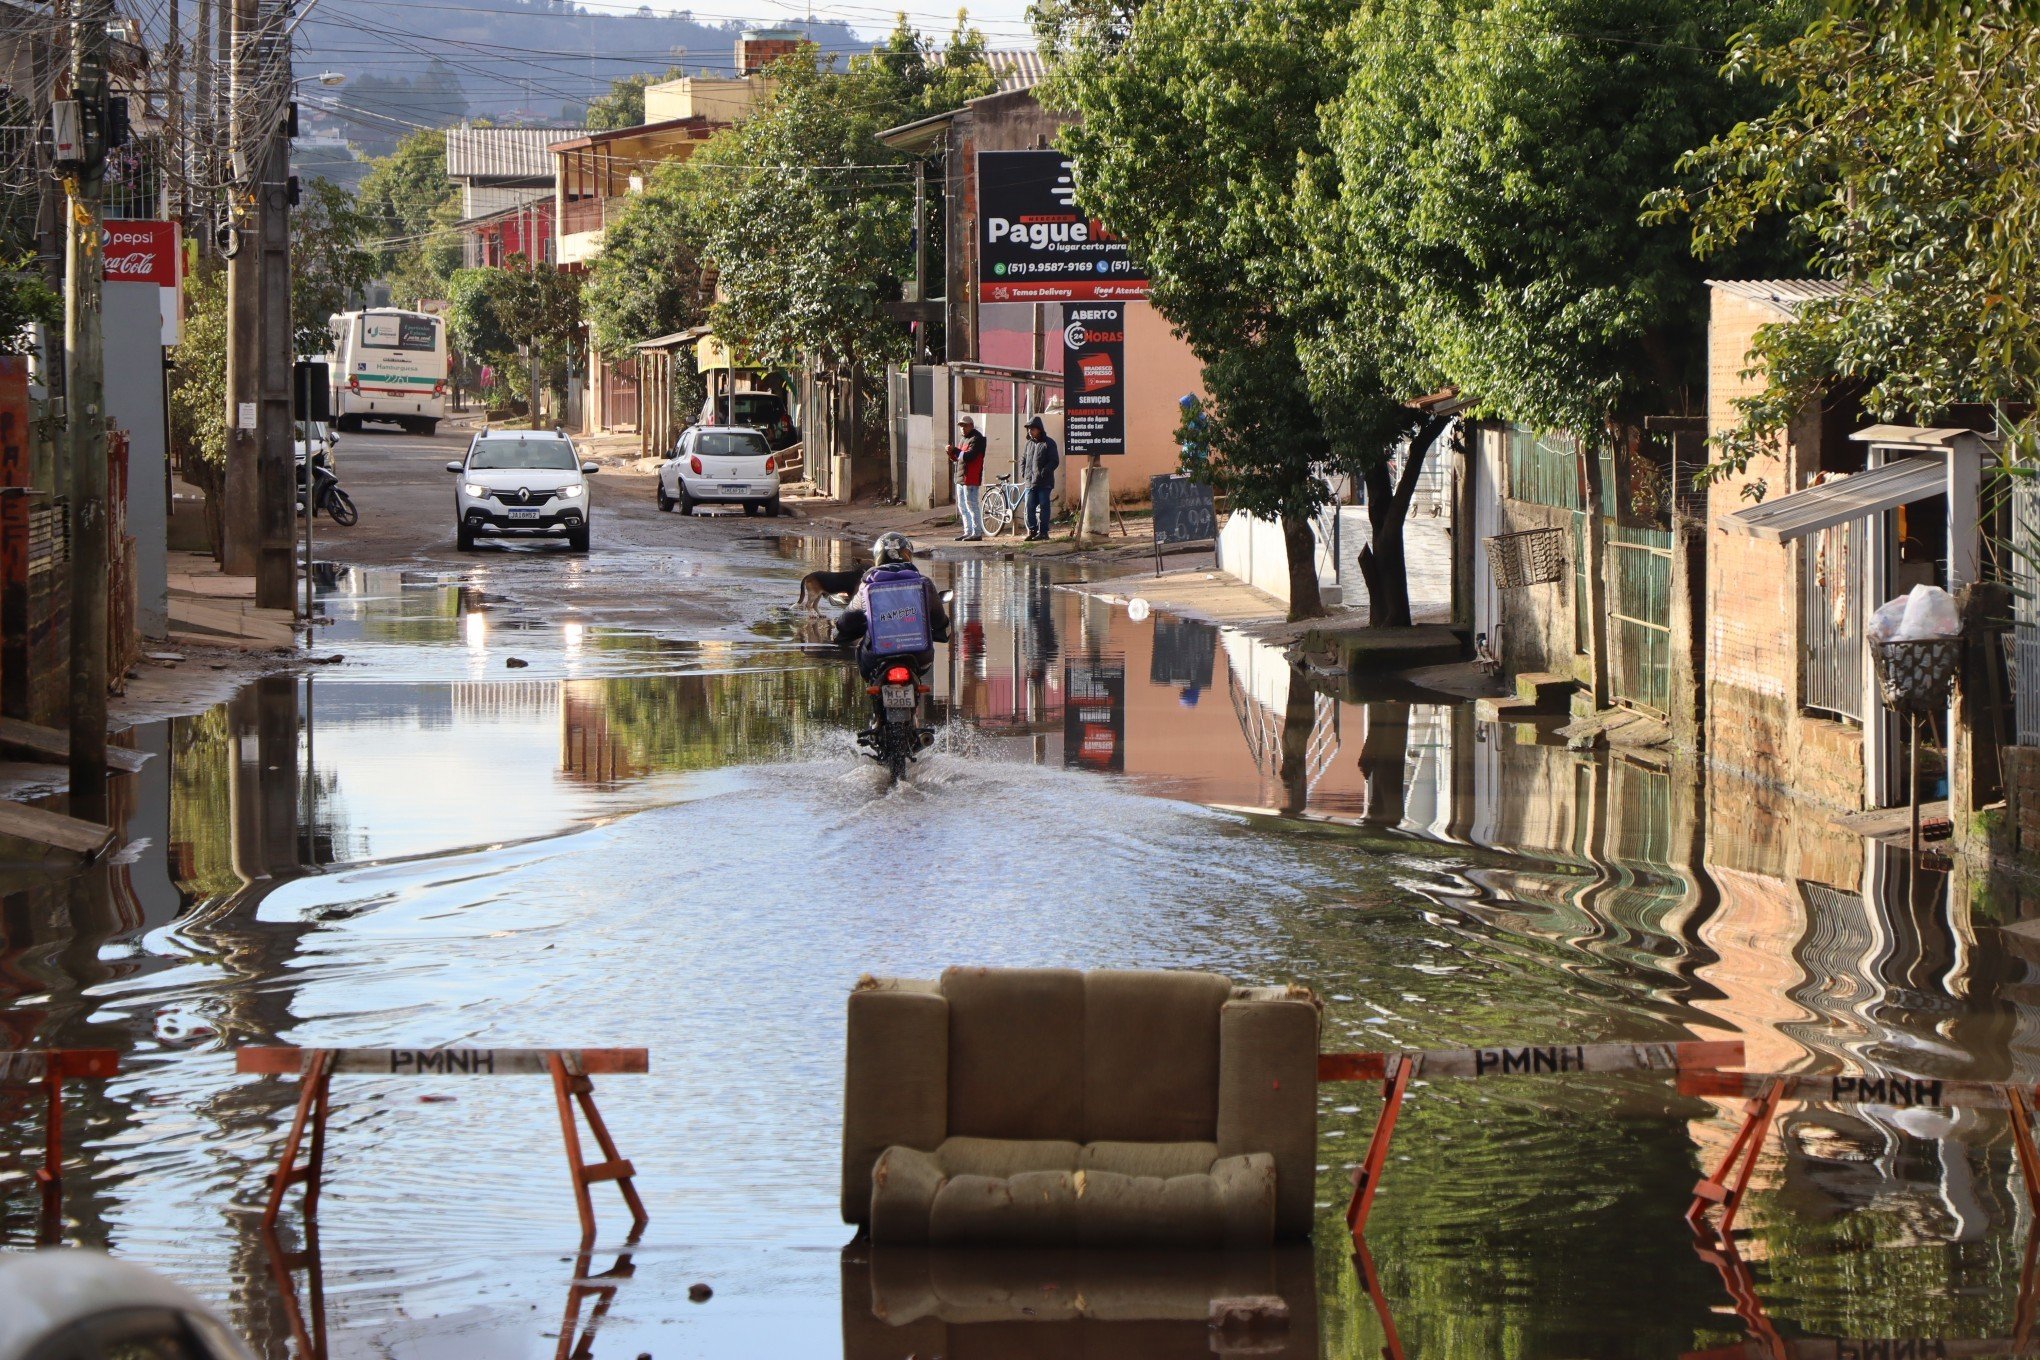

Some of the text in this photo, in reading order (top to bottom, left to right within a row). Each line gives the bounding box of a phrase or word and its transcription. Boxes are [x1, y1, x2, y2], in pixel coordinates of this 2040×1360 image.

[113, 231, 154, 246] pepsi
[988, 217, 1125, 250] PagueM
[1048, 243, 1127, 253] O lugar certo para
[101, 252, 157, 274] ca-Cola
[1007, 263, 1027, 275] (51)
[1028, 262, 1093, 273] 9.9587-9169
[1110, 260, 1130, 273] (51)
[1012, 288, 1038, 297] Temos
[1038, 287, 1073, 298] Delivery
[1071, 309, 1118, 320] ABERTO
[1084, 330, 1124, 343] HORAS
[376, 363, 419, 372] Hamburguesa
[1079, 395, 1111, 405] SERVIÇOS
[1067, 408, 1105, 416] PAGAMENTOS
[1095, 415, 1109, 423] Água
[390, 1048, 494, 1074] PMNH
[1474, 1045, 1584, 1076] PMNH
[1831, 1076, 1942, 1106] PMNH
